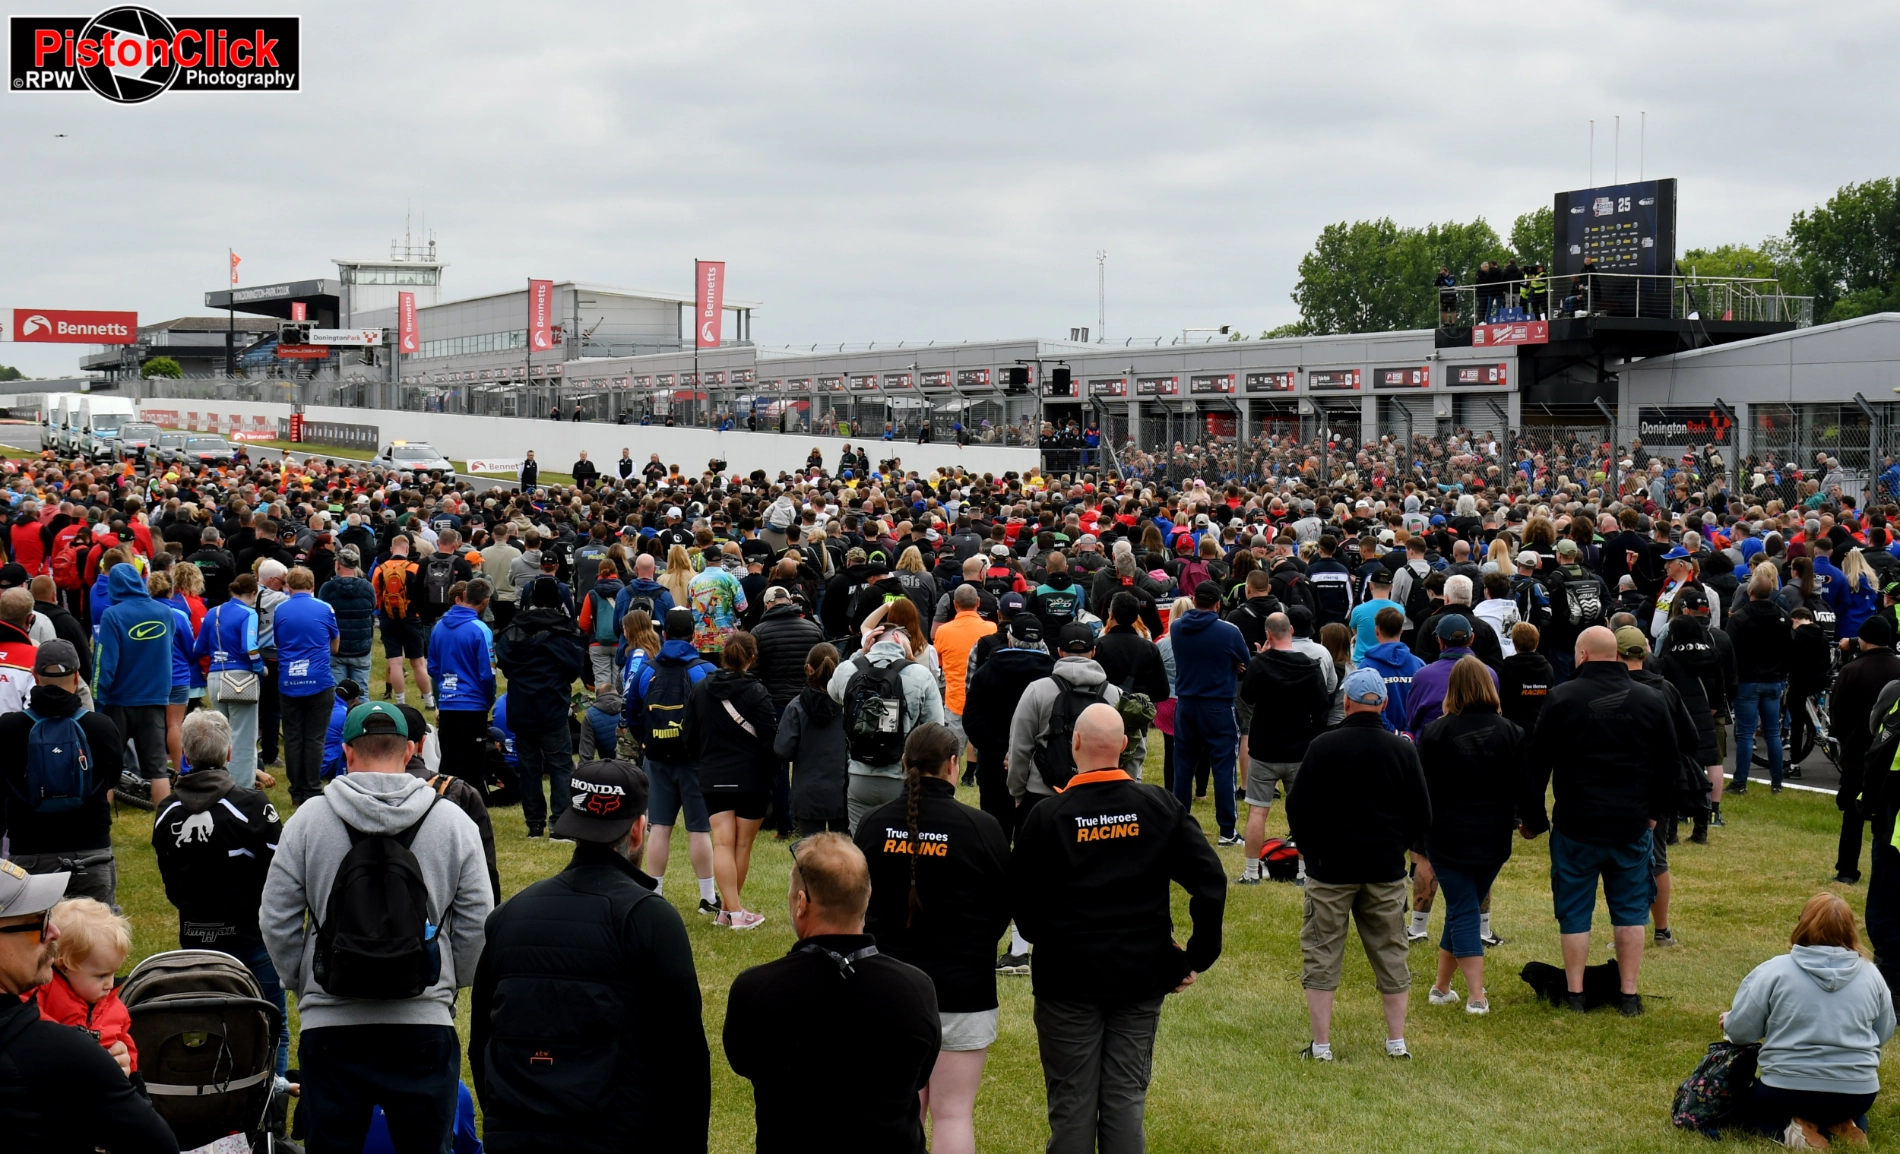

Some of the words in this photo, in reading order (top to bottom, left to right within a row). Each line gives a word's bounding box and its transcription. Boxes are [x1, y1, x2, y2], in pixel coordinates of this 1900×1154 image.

[1618, 197, 1631, 213] 25
[705, 266, 717, 317] Bennetts
[537, 284, 546, 328] Bennetts
[57, 321, 128, 336] Bennetts
[1813, 610, 1836, 622] VANS
[653, 728, 679, 738] PUMA
[571, 778, 626, 795] HONDA
[1075, 816, 1098, 828] True
[1099, 813, 1138, 825] Heroes
[886, 828, 909, 839] True
[918, 833, 948, 842] eroes
[1077, 823, 1139, 842] RACING
